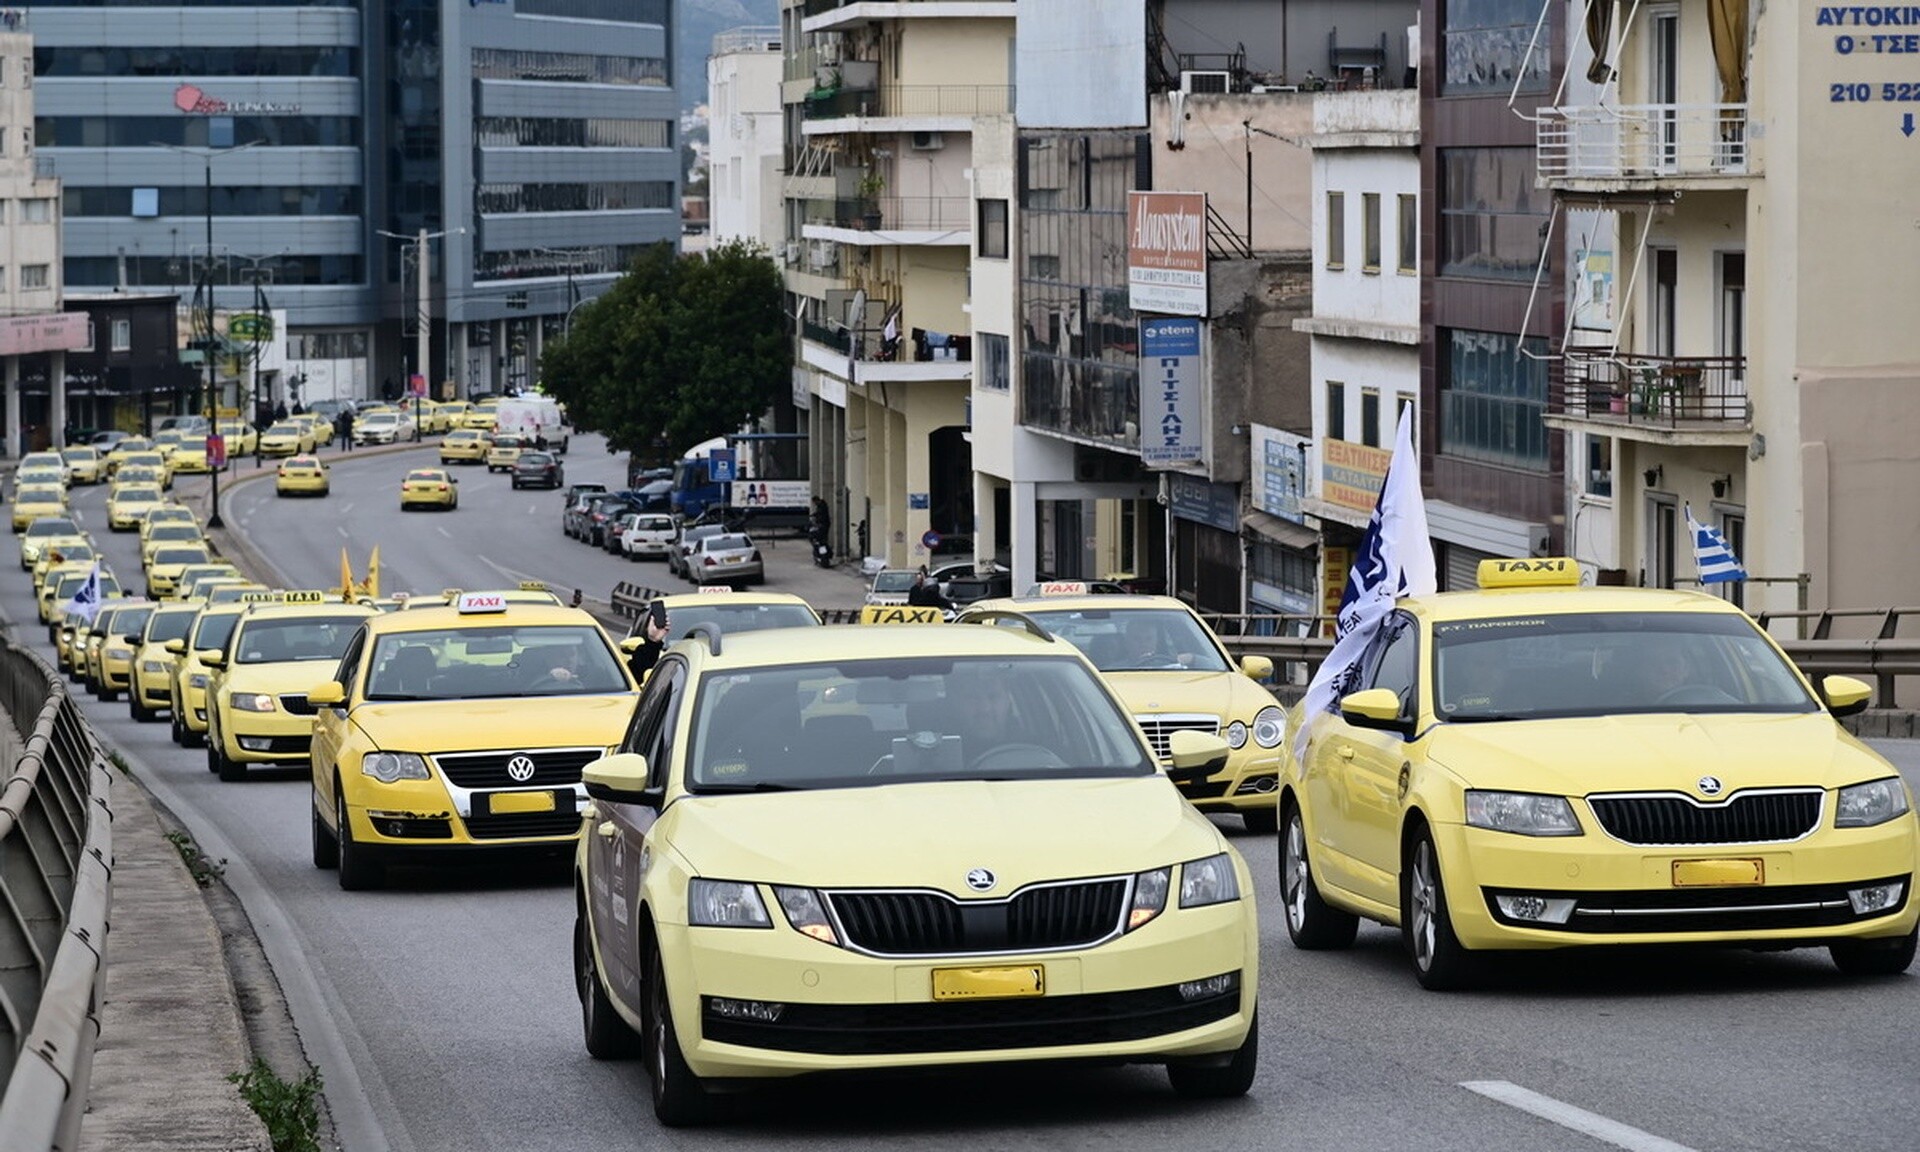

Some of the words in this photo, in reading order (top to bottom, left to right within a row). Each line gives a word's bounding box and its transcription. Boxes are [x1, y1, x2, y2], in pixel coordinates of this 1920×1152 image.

[1830, 83, 1871, 102] 210
[1882, 83, 1920, 102] 522
[1159, 325, 1195, 336] etem
[1161, 357, 1182, 447] ΠΙΤΣΙΛΗΣ
[1327, 442, 1390, 474] ΕΞΑΤΜΙΣΕ
[1495, 560, 1565, 572] TAXI
[1044, 584, 1080, 594] TAXI
[286, 591, 321, 602] TAXI
[465, 597, 501, 607] TAXI
[870, 608, 937, 624] TAXI
